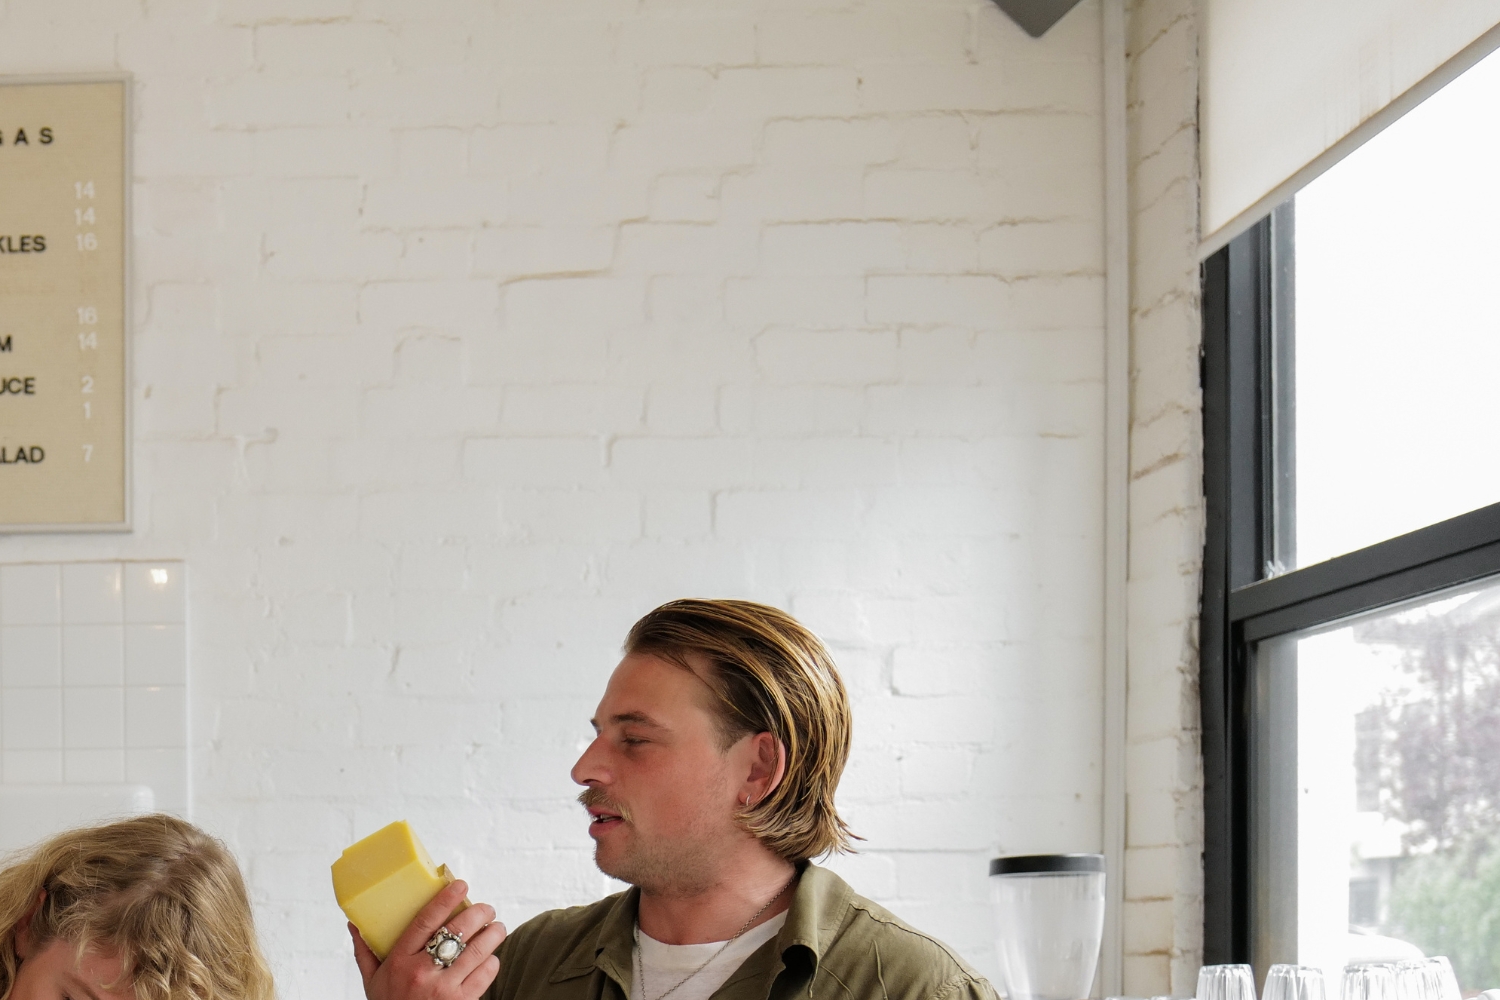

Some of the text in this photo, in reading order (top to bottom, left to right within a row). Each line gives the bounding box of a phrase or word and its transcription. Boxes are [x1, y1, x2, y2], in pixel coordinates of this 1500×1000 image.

[73, 181, 96, 200] 14
[73, 207, 96, 226] 14
[75, 234, 99, 253] 16
[76, 307, 99, 326] 16
[77, 332, 99, 351] 14
[80, 376, 95, 395] 2
[82, 402, 92, 421] 1
[81, 444, 94, 464] 7
